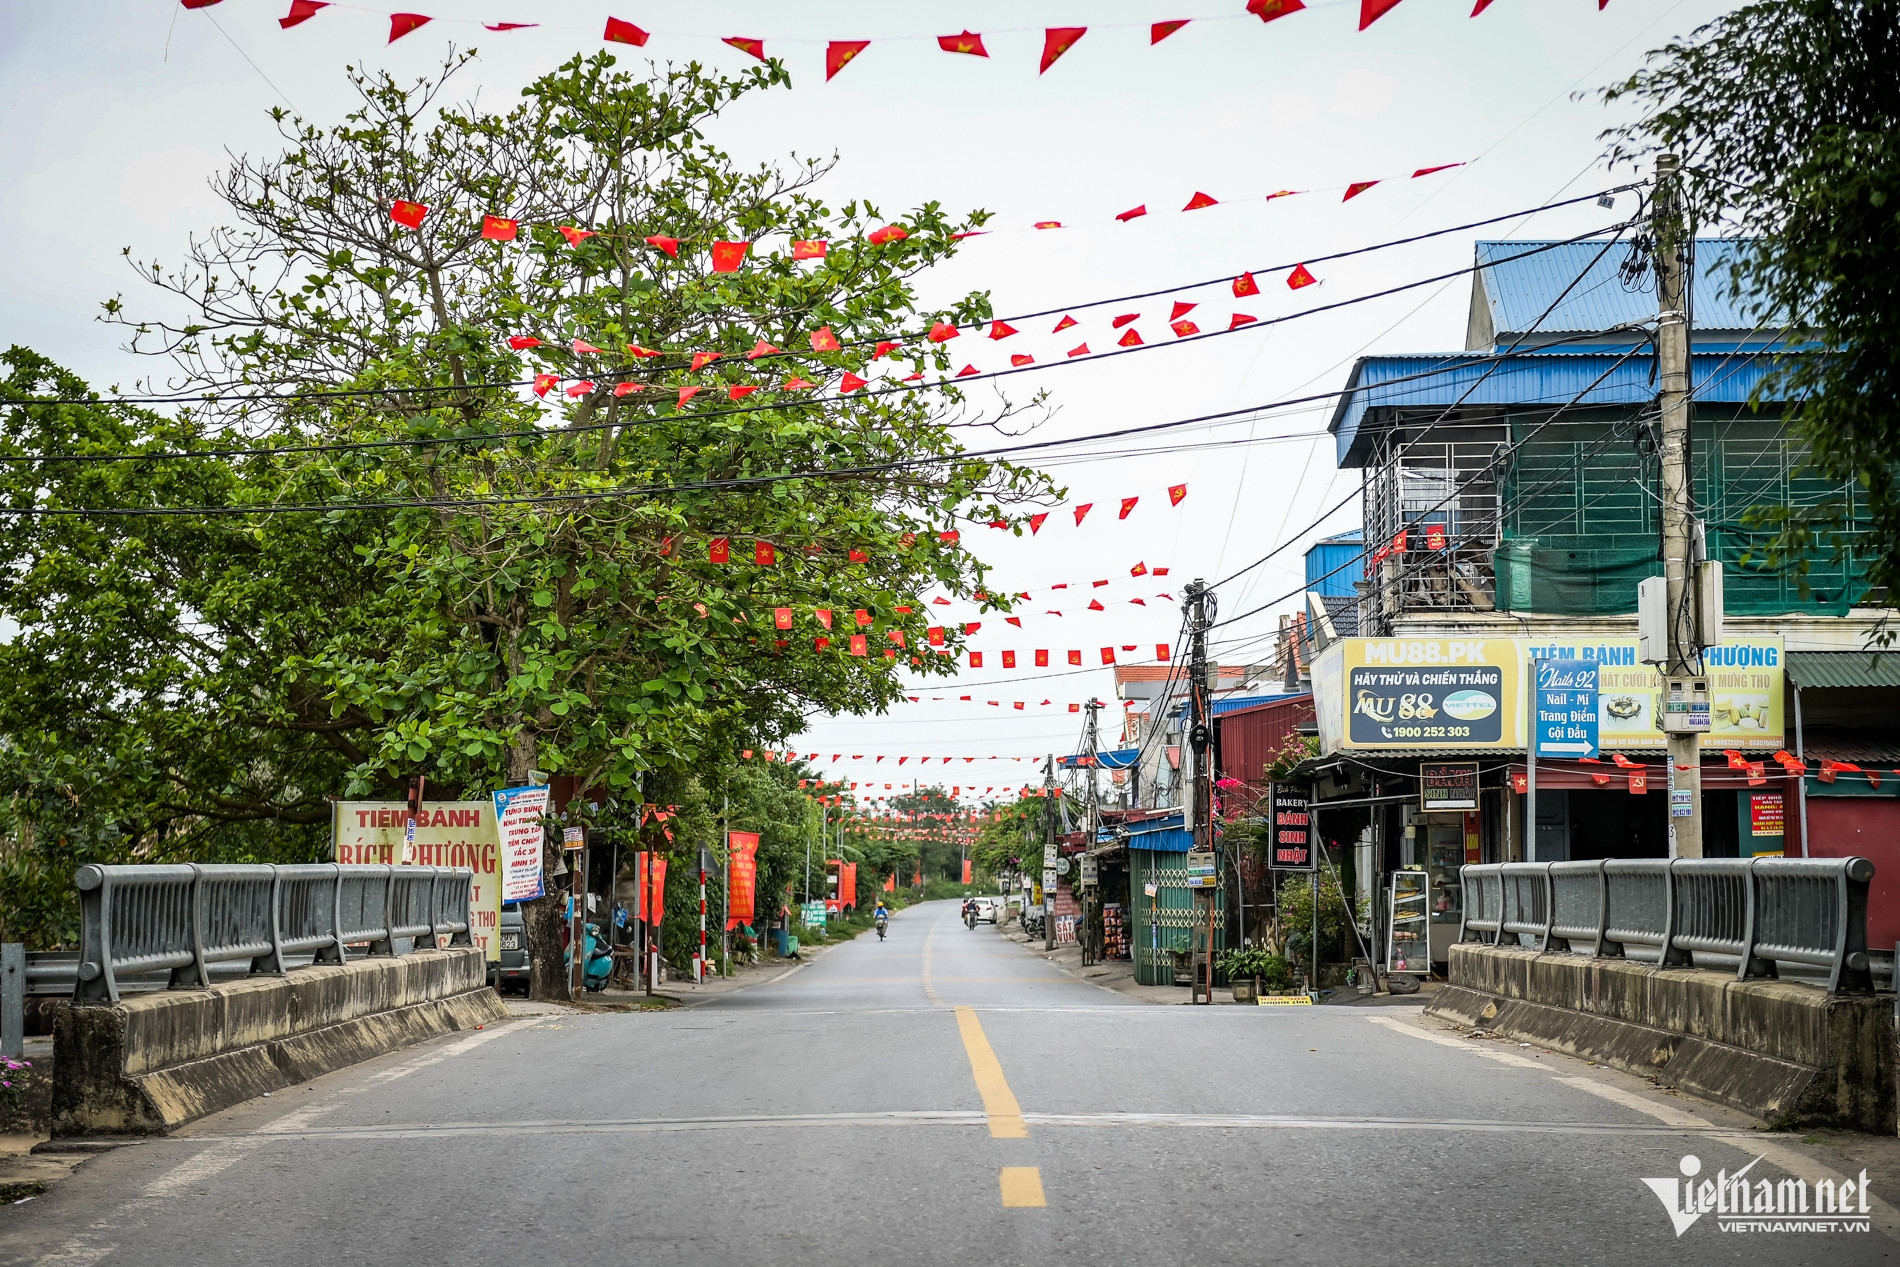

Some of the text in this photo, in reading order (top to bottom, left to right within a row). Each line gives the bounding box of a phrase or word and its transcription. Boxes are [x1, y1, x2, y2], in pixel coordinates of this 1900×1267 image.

[1365, 641, 1487, 665] MU88.PK
[1582, 644, 1635, 666] BÁNH
[1354, 668, 1499, 686] HÃY THỬ VÀ CHIẾN THẮNG
[1538, 662, 1596, 689] Nails 92
[1599, 671, 1620, 690] HẬT
[1718, 671, 1748, 688] MỪNG
[1750, 674, 1771, 691] THỌ
[1353, 688, 1440, 723] MU 88
[1546, 693, 1567, 705] Nail
[1539, 707, 1596, 725] Trang Điểm
[1393, 726, 1470, 738] 1900 252 303
[1548, 724, 1588, 741] Gội Đầu
[1424, 786, 1476, 800] SINH NHẬT
[1276, 798, 1309, 808] BAKERY
[356, 807, 409, 832] TIỆM
[415, 806, 480, 828] BÁNH
[503, 818, 518, 828] KHAI
[1276, 810, 1309, 826] BÁNH
[508, 828, 529, 837] TRUNG
[1278, 830, 1307, 844] SINH
[1276, 847, 1308, 865] NHẬT
[478, 911, 496, 931] THỌ
[1057, 920, 1072, 933] SẮT
[502, 940, 516, 949] 623
[1058, 932, 1075, 943] VỤN
